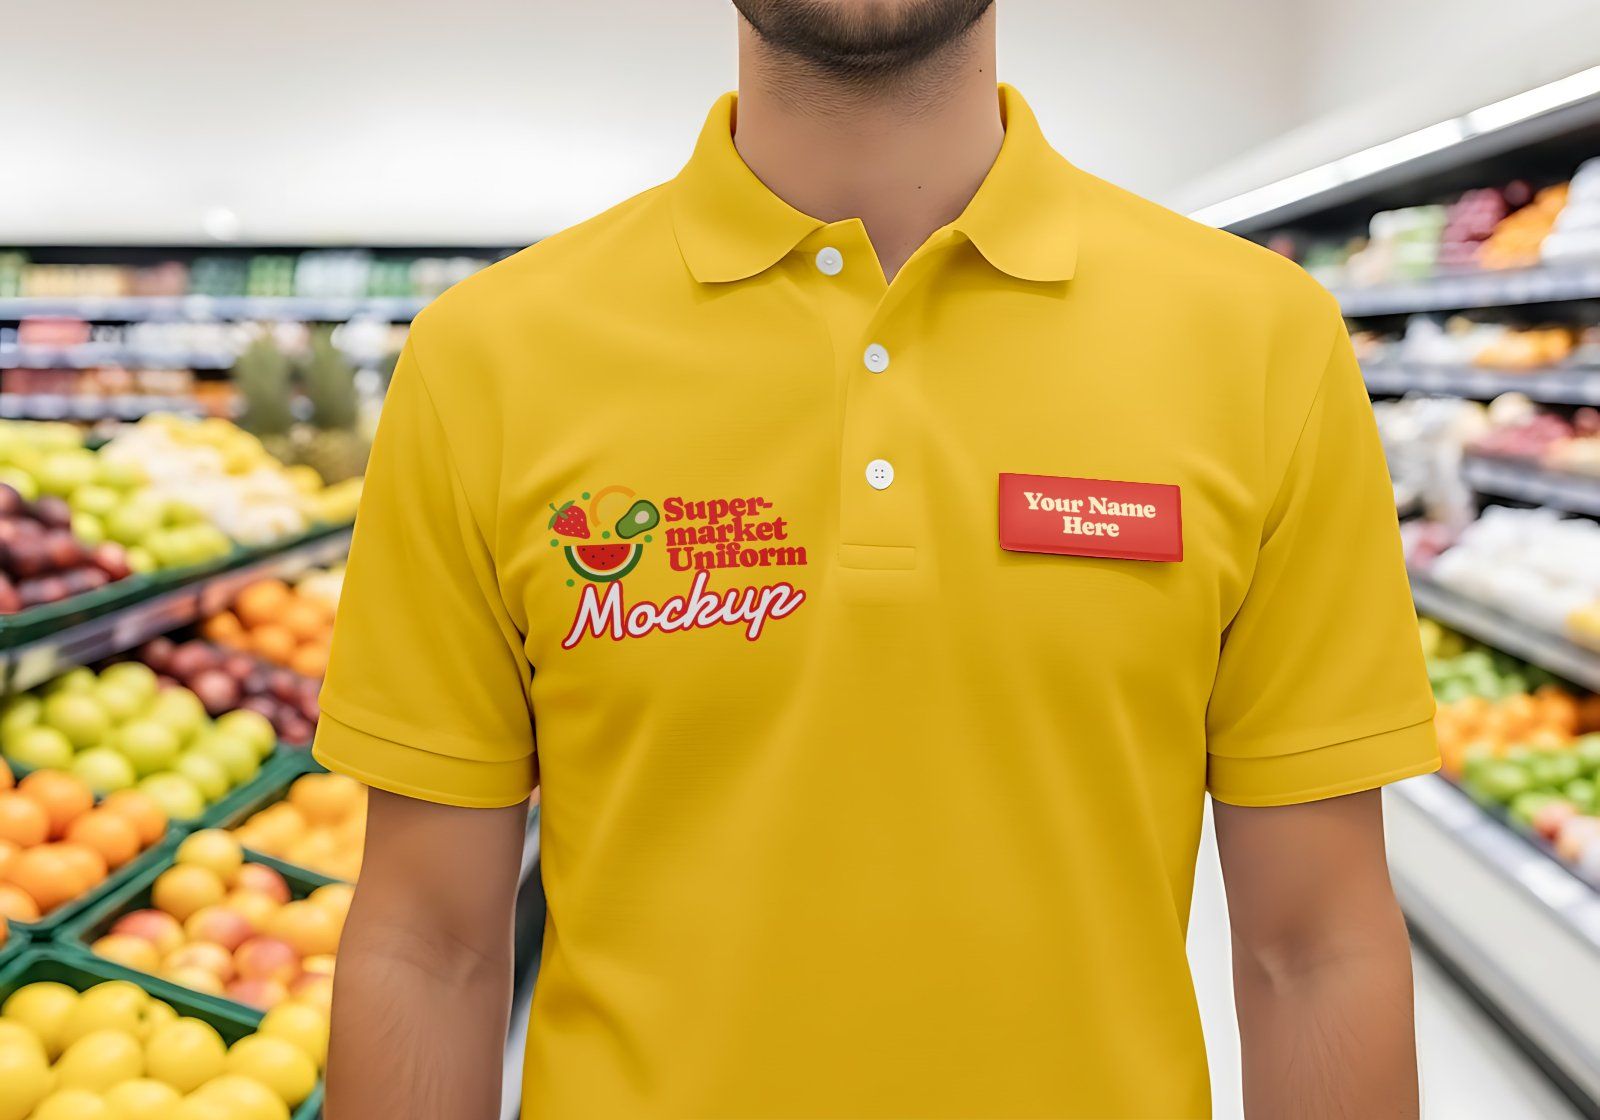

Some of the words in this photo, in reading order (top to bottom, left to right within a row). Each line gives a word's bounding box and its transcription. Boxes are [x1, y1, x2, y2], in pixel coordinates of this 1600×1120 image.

[663, 496, 773, 524] Super-
[1023, 491, 1083, 513] Your
[1088, 496, 1156, 518] Name
[665, 516, 788, 547] market
[1062, 516, 1119, 537] Here
[666, 542, 808, 572] Uniform
[561, 569, 807, 650] Mockup
